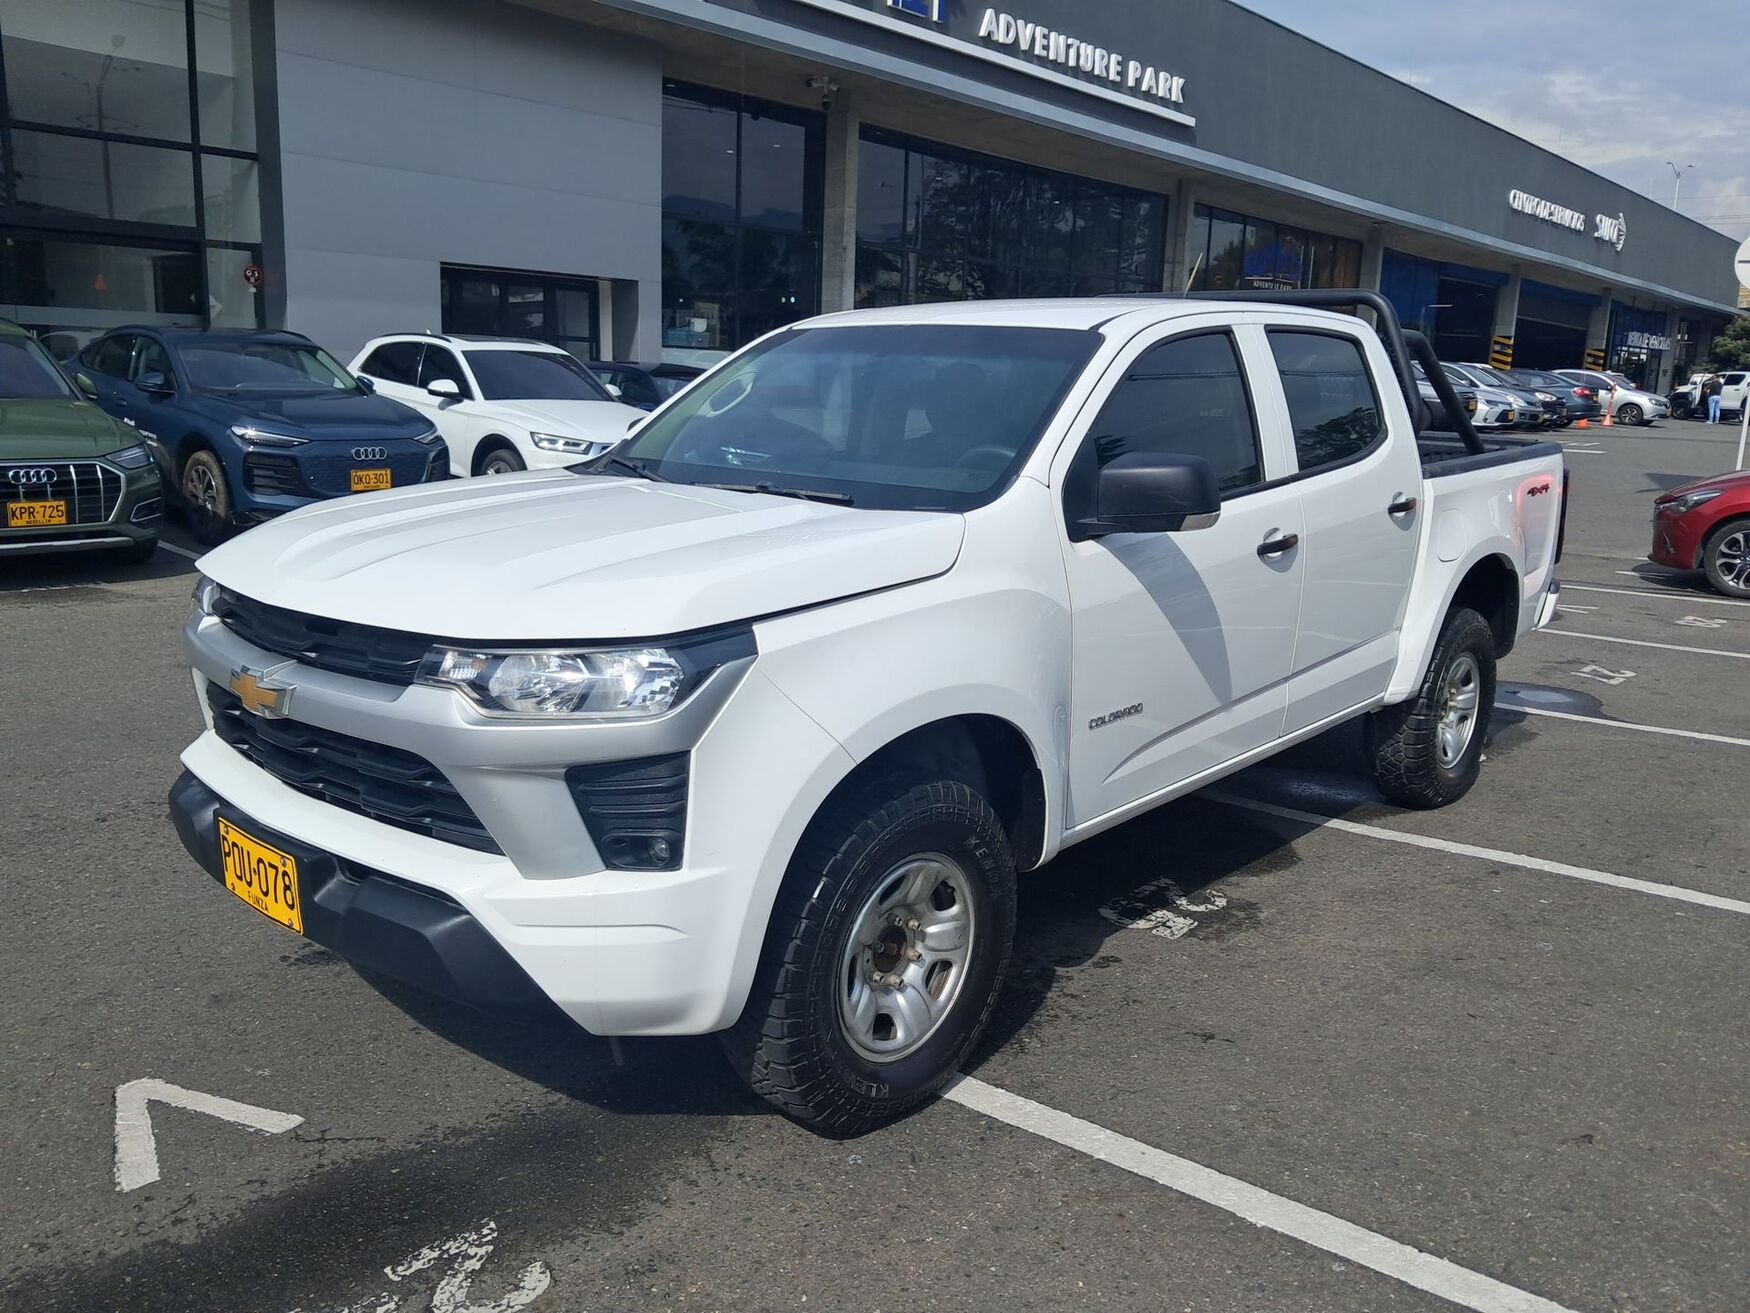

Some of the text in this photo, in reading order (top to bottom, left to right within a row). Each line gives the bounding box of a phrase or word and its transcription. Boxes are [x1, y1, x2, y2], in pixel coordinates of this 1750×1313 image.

[978, 8, 1122, 82] ADVENTURE
[1127, 60, 1186, 103] PARK
[10, 504, 65, 521] KPR-725
[1088, 702, 1144, 731] COLORADO
[221, 834, 296, 911] POU-078
[247, 890, 269, 914] FUNZA
